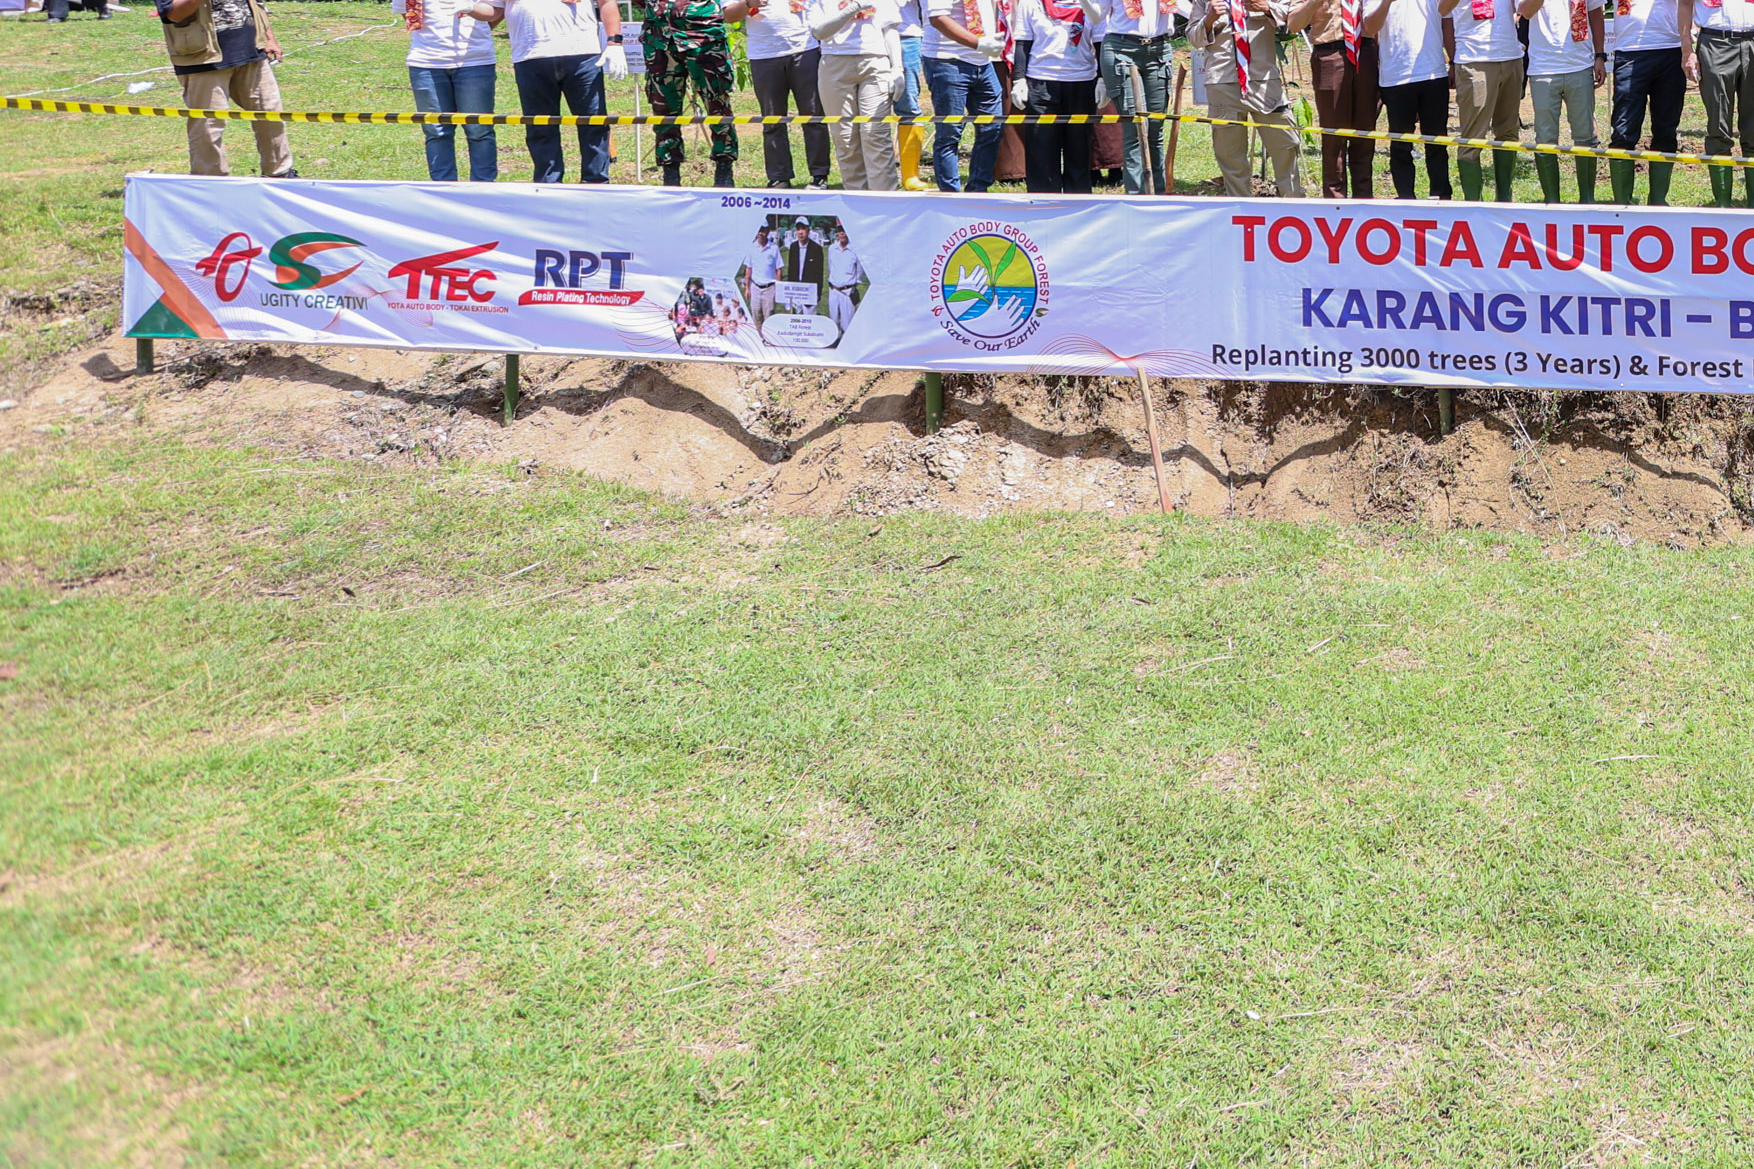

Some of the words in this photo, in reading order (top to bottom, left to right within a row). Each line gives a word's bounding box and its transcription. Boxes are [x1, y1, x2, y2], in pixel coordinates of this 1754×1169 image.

[721, 196, 752, 208] 2006
[1232, 215, 1484, 268] TOYOTA
[1497, 221, 1674, 273] AUTO
[534, 248, 634, 290] RPT
[930, 254, 946, 301] TOYOTA
[942, 227, 968, 254] AUTO
[969, 222, 1001, 235] BODY
[1003, 224, 1039, 254] GROUP
[1034, 255, 1050, 304] FOREST
[260, 293, 300, 308] UGITY
[531, 291, 554, 302] Resin
[556, 292, 585, 304] Plating
[586, 292, 631, 305] Technology
[1302, 288, 1527, 334] KARANG
[1540, 295, 1671, 338] KITRI
[940, 320, 971, 346] Save
[974, 339, 1003, 352] Our
[1004, 317, 1040, 350] Earth
[1212, 344, 1353, 372] Replanting
[1360, 347, 1420, 370] 3000
[1428, 349, 1496, 371] trees
[1504, 350, 1528, 376] (3
[1536, 352, 1622, 379] Years)
[1629, 354, 1648, 376] &
[1658, 356, 1744, 378] Forest
